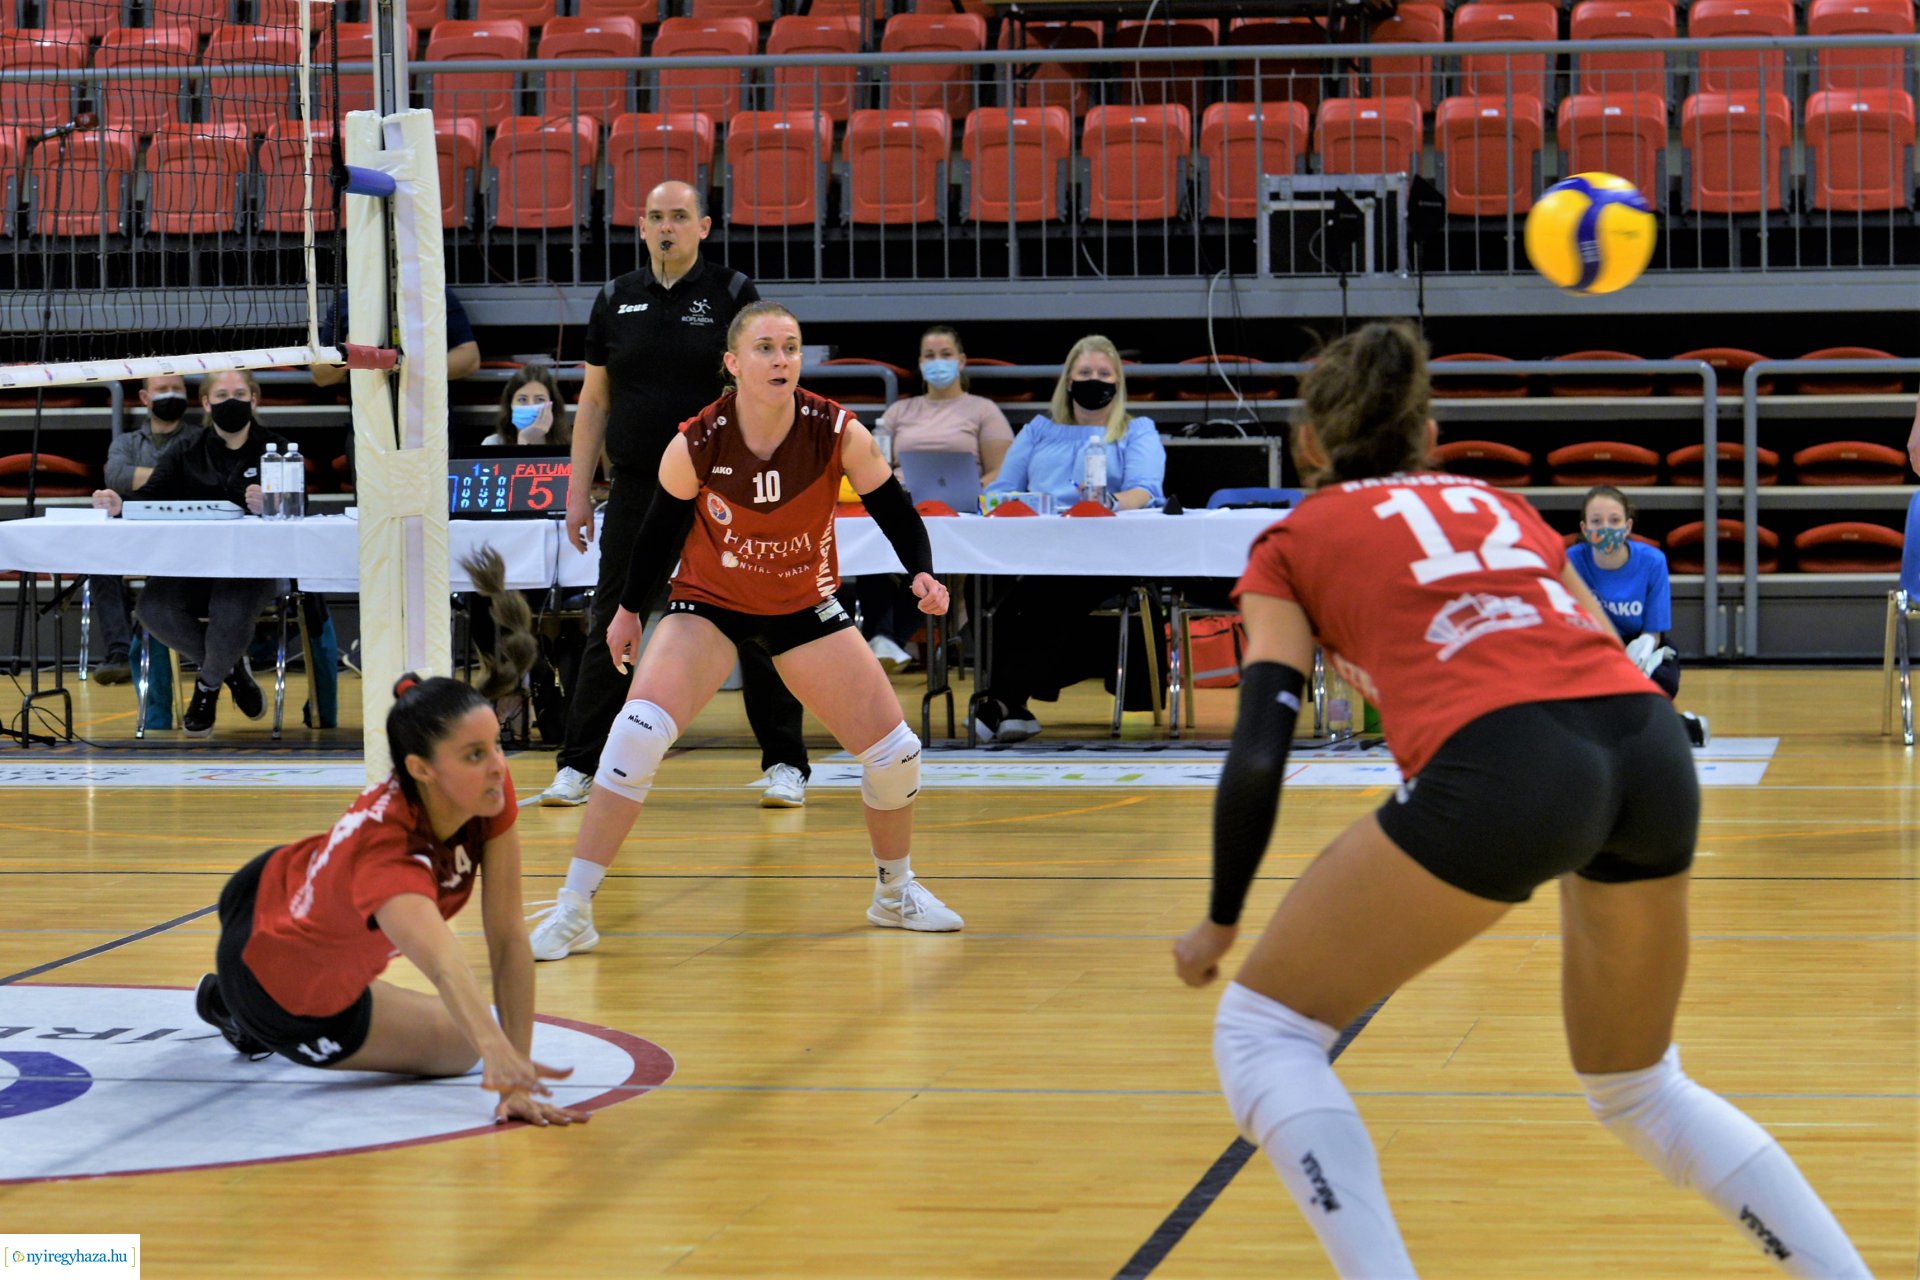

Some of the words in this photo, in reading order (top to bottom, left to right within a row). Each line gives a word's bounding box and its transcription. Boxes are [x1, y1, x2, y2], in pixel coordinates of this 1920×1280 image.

[617, 303, 649, 314] Zeus
[515, 463, 572, 476] FATUM
[527, 476, 554, 510] 5
[752, 470, 781, 504] 10
[1372, 486, 1546, 586] 12
[296, 1036, 343, 1062] 14
